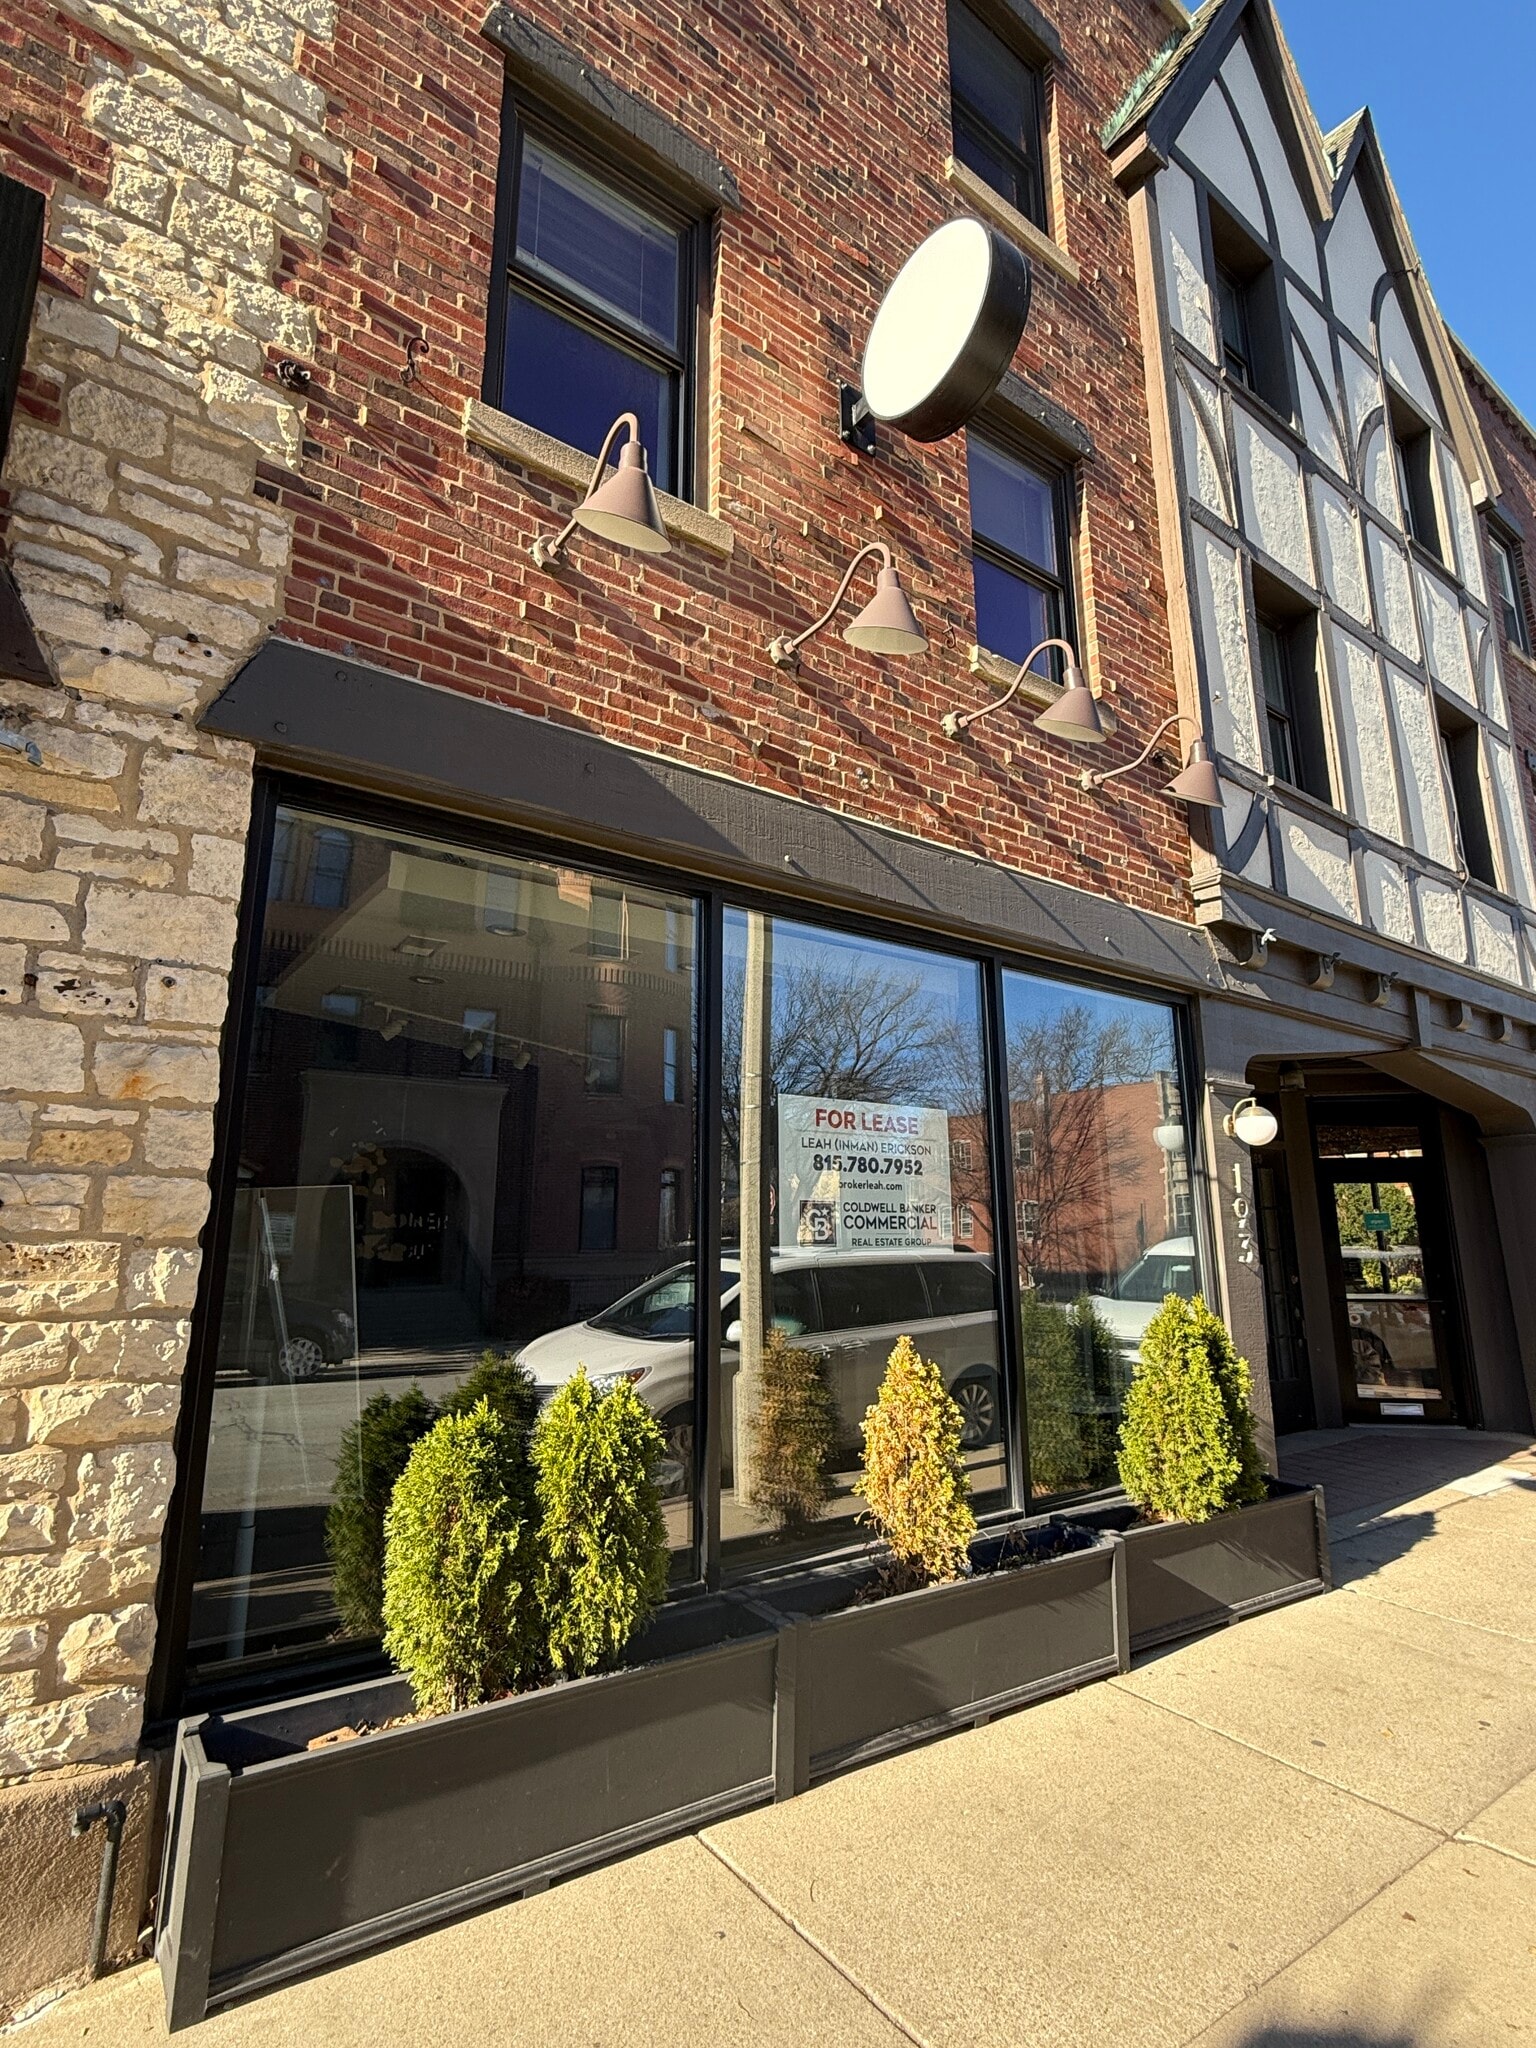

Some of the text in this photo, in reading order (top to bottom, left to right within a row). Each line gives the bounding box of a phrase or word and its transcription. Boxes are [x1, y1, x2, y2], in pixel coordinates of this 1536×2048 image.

[815, 1108, 919, 1135] FOR LEASE
[801, 1137, 932, 1156] LEAH (INMAN) ERICKSON
[813, 1154, 923, 1176] 815.780.7952
[843, 1201, 937, 1214] COLDWELL BANKER
[843, 1214, 938, 1231] COMMERCIAL
[851, 1236, 932, 1247] REAL ESTATE GROUP
